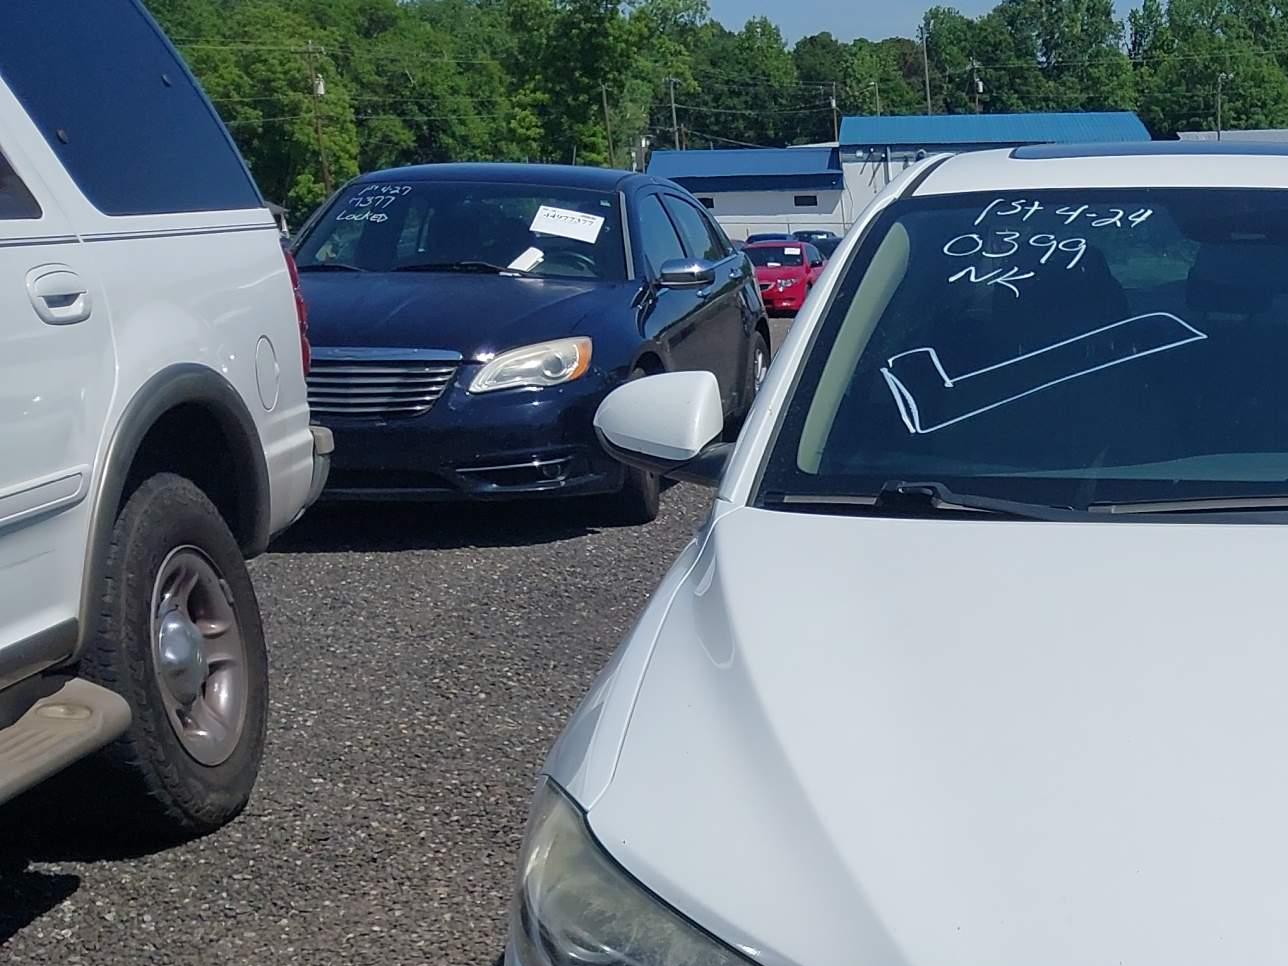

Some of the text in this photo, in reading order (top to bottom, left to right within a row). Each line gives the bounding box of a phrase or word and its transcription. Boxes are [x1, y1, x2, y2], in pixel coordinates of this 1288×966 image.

[1055, 204, 1153, 228] 4-24
[943, 231, 1087, 270] 0399
[948, 265, 1035, 298] NK
